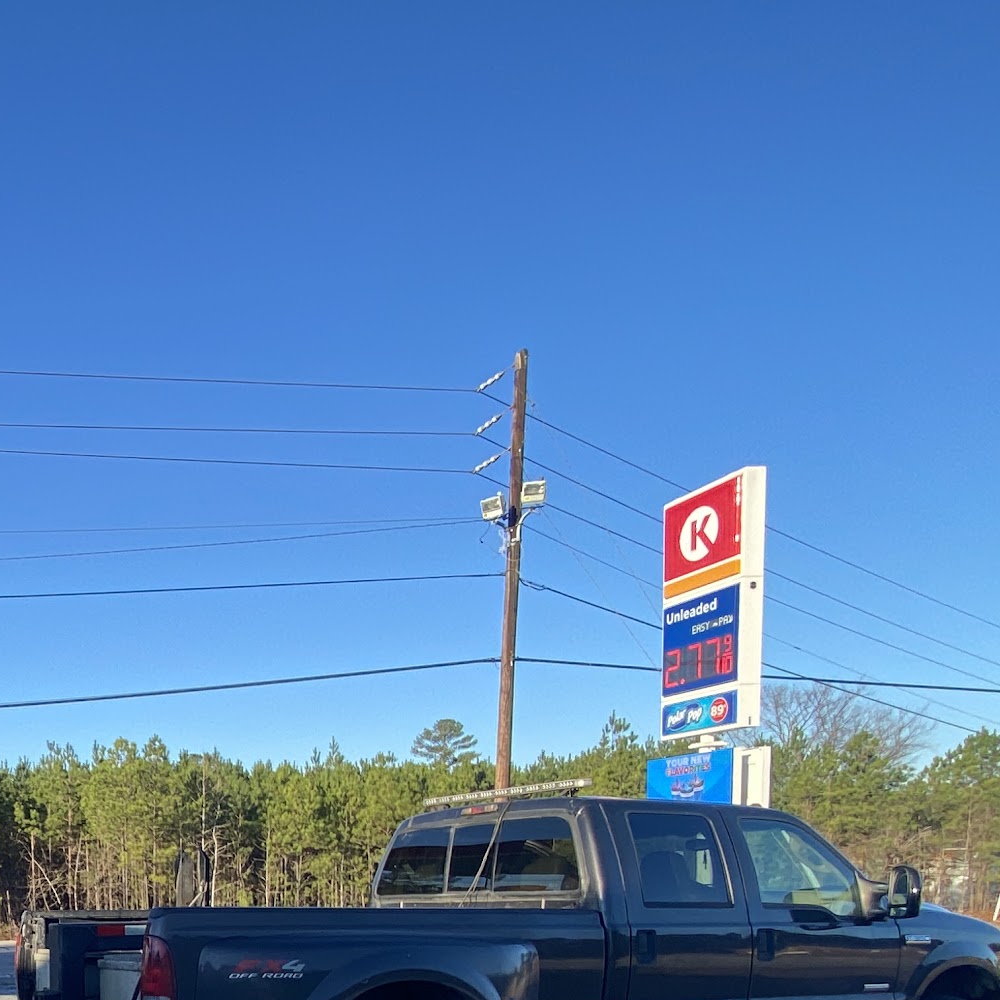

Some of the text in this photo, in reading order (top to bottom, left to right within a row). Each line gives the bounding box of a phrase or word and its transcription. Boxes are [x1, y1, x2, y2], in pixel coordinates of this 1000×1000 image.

[688, 510, 715, 554] K
[666, 597, 718, 625] Unleaded
[691, 614, 734, 635] EASY PAY
[667, 706, 703, 728] Polar Pop
[666, 754, 711, 768] YOUR NEW
